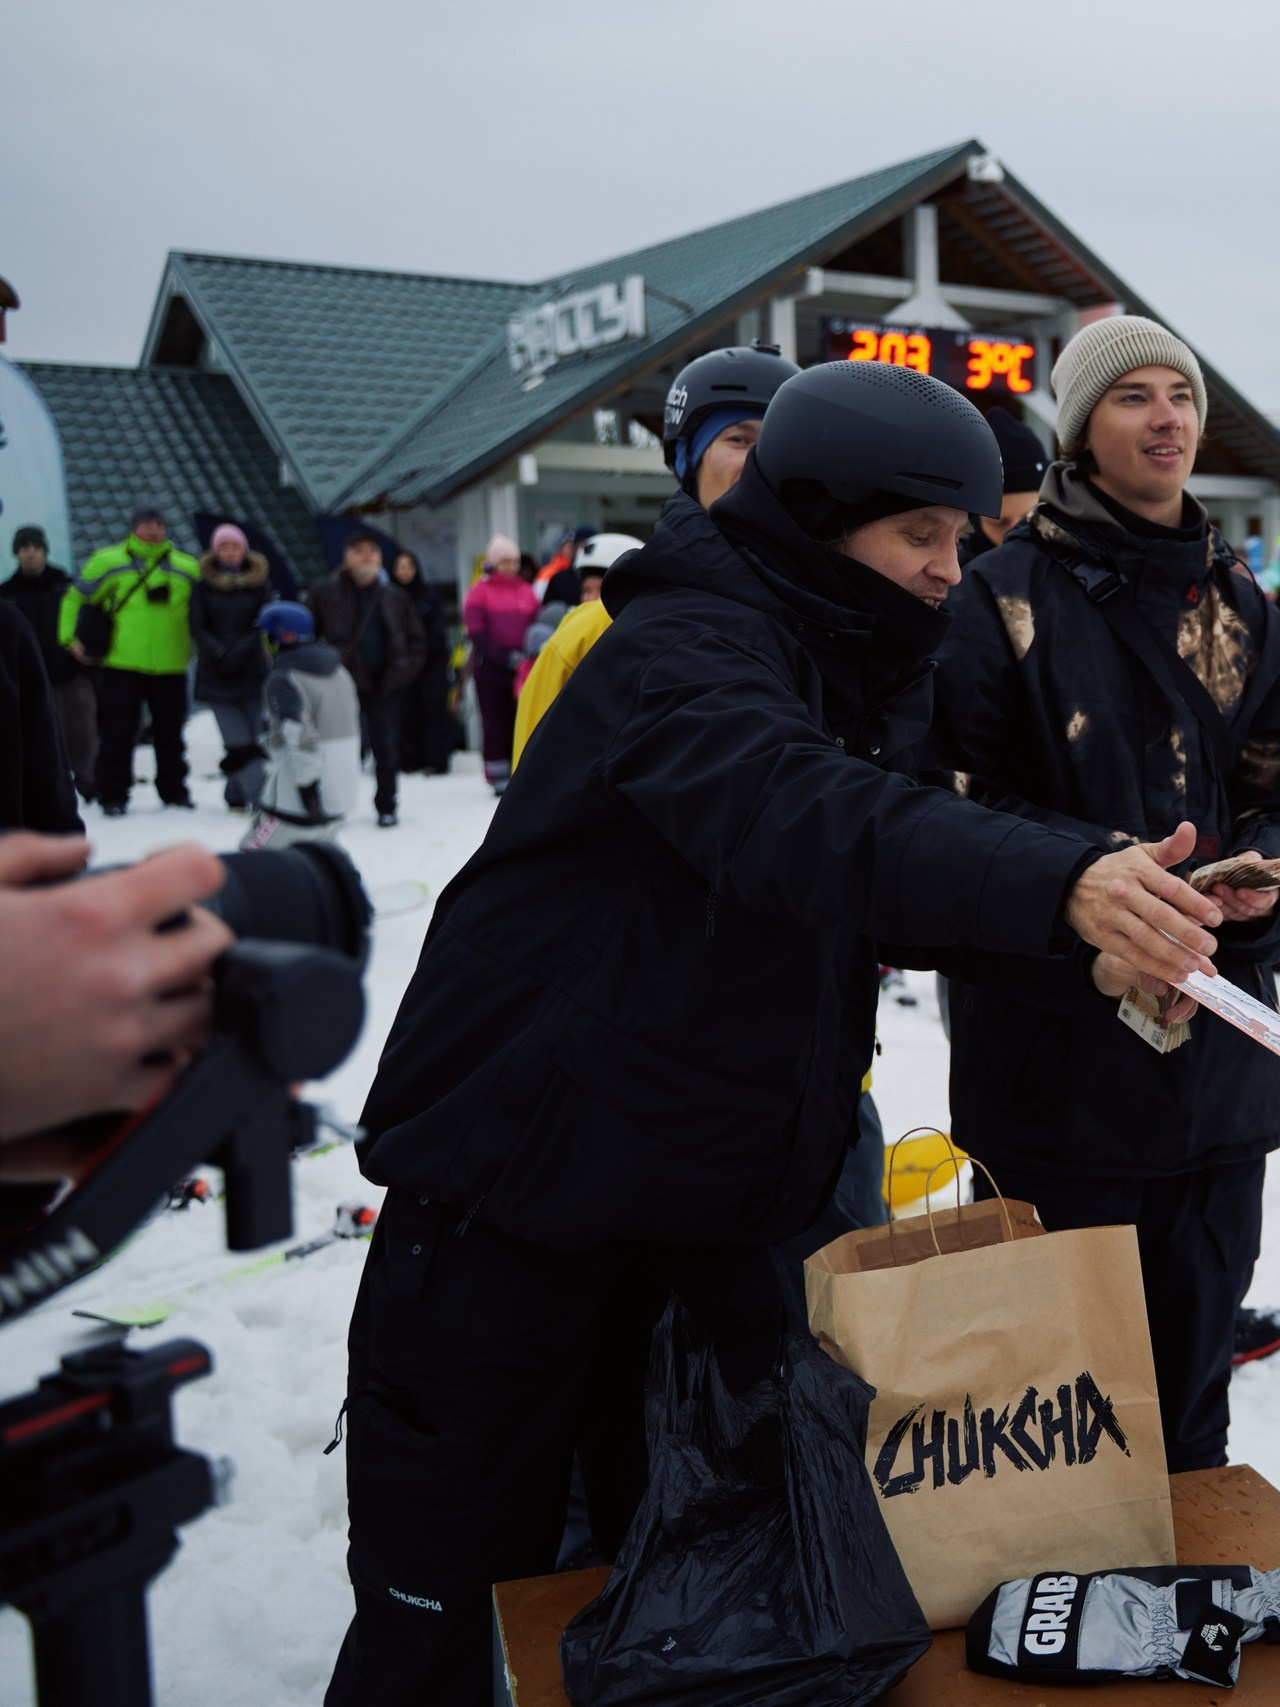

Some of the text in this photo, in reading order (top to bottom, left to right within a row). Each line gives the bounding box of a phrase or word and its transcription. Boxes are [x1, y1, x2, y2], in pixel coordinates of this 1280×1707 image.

[873, 1371, 1131, 1498] CHUKCHA
[389, 1587, 443, 1611] CHUKCHA
[1024, 1575, 1079, 1655] GRAB
